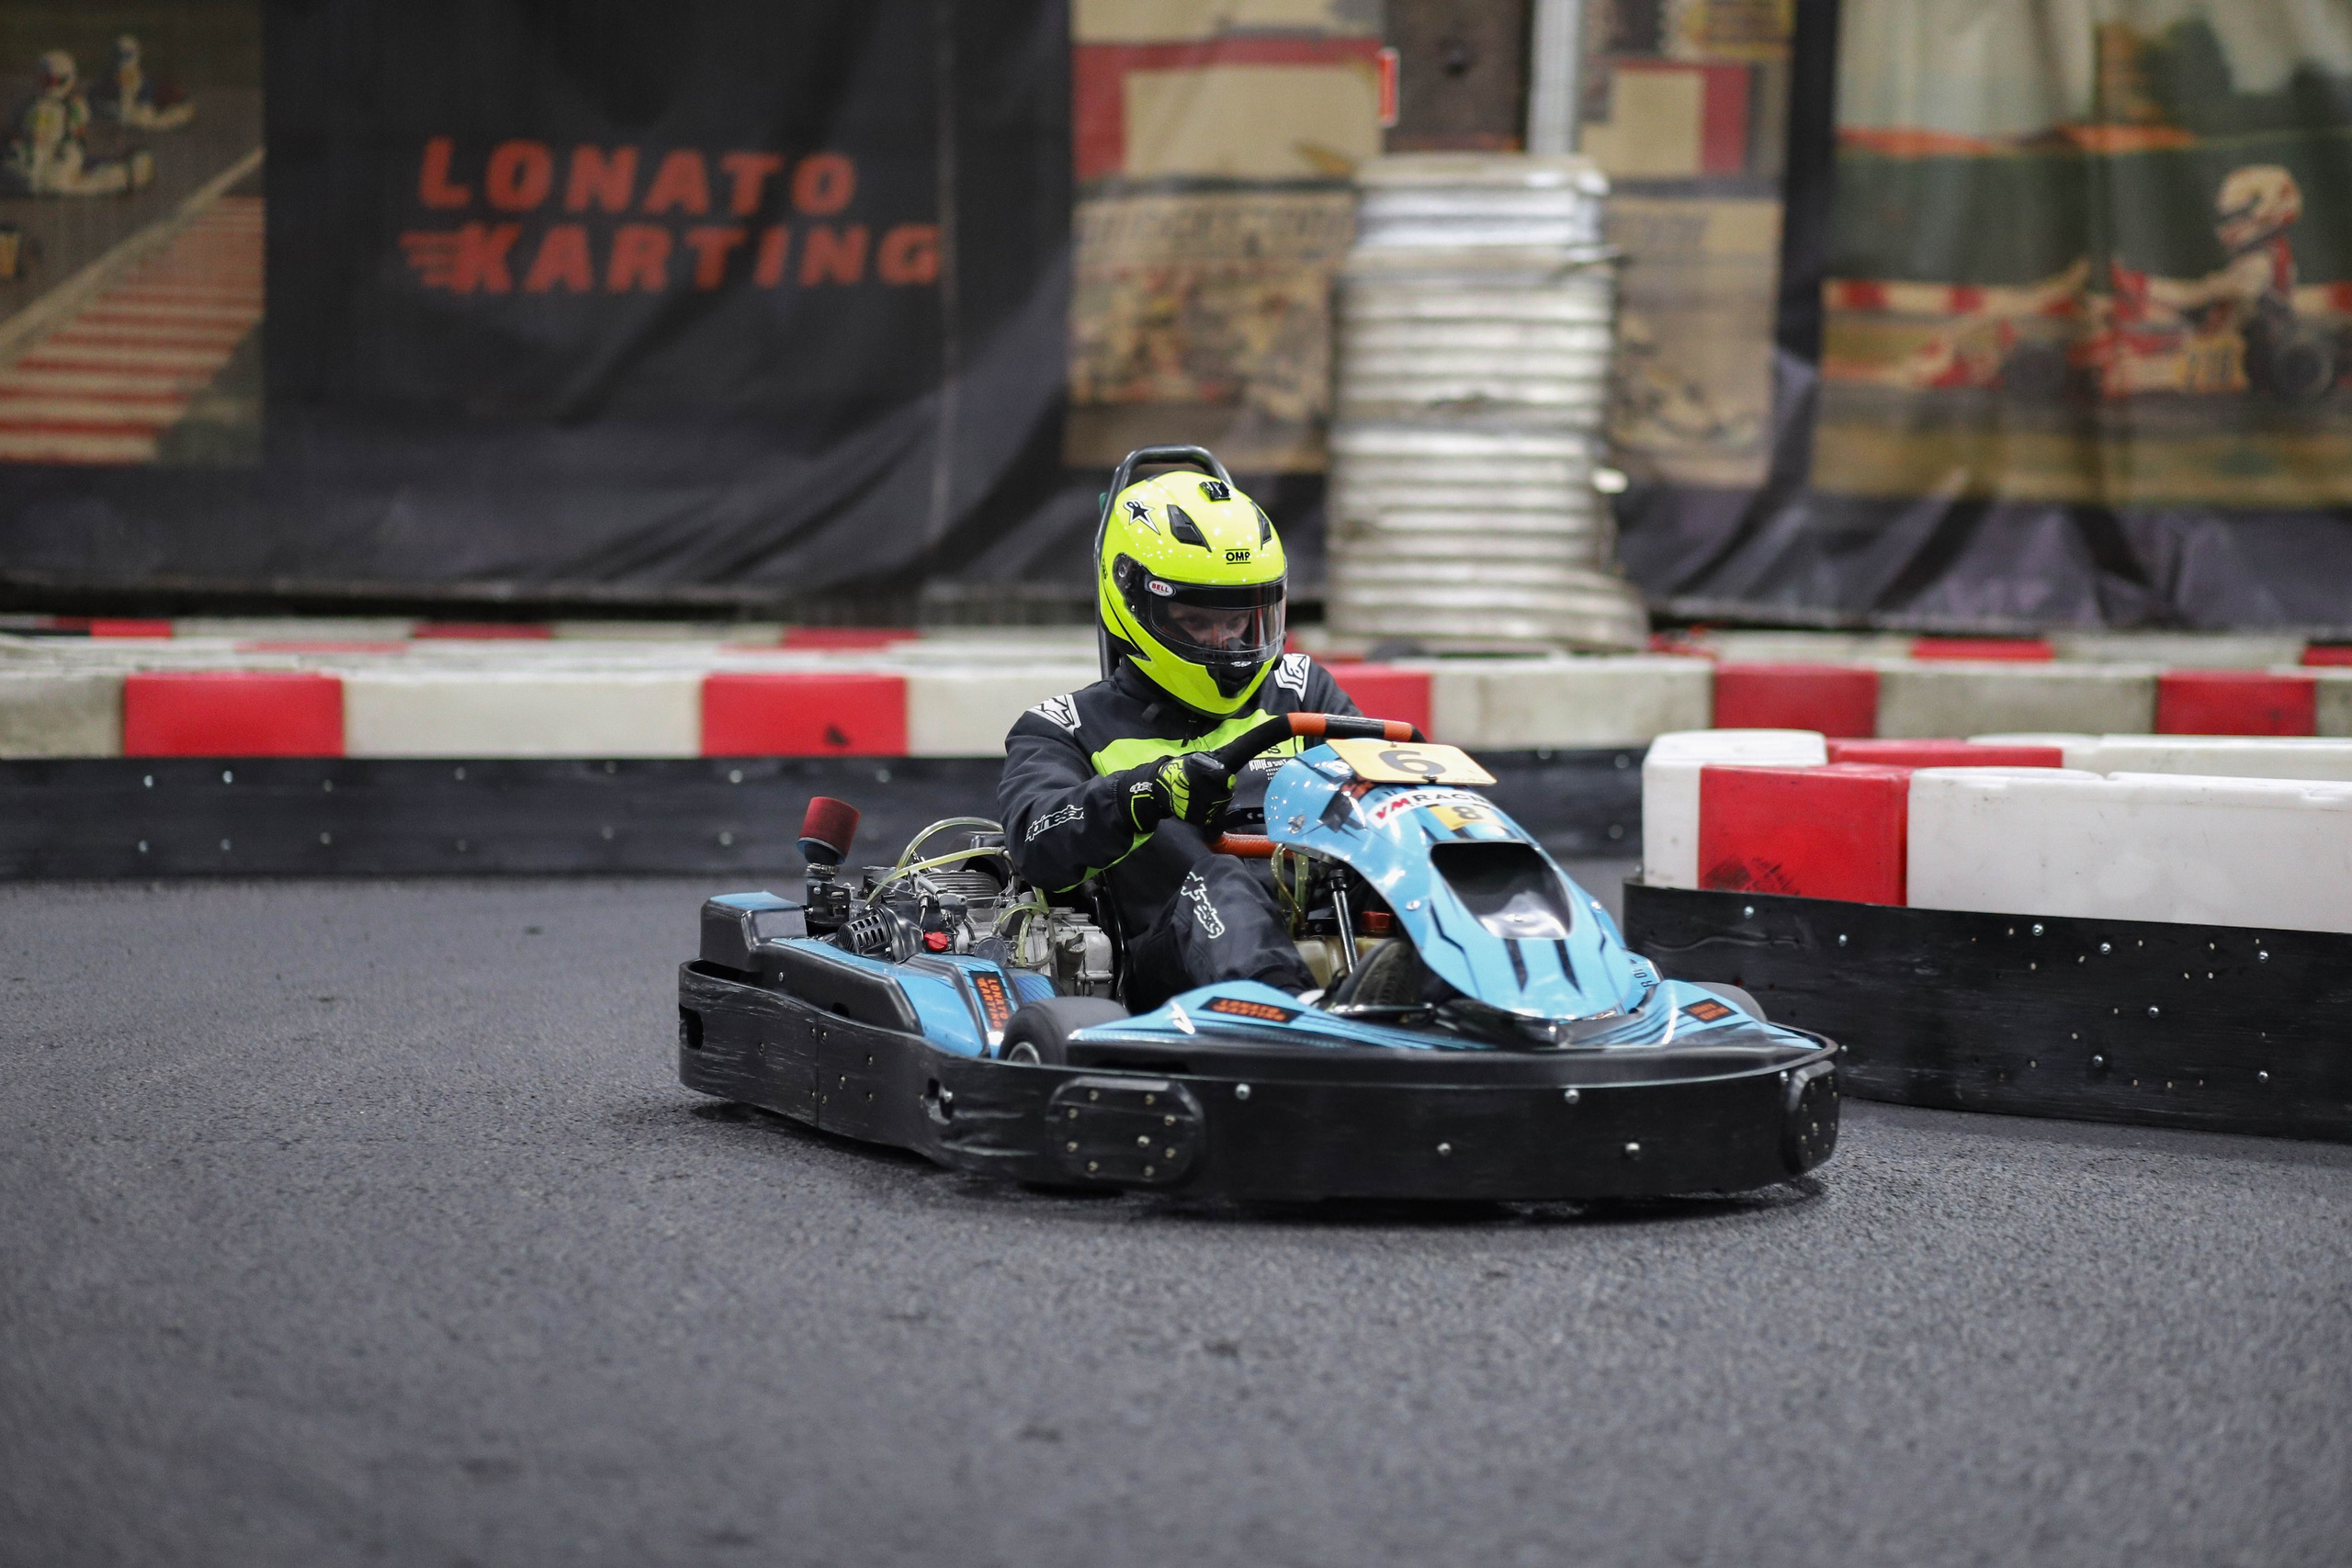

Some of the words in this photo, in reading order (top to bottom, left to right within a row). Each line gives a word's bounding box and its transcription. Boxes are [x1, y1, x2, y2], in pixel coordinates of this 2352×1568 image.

[419, 136, 857, 215] LONATO
[446, 223, 943, 293] KARTING
[1226, 551, 1250, 561] OMP
[1151, 582, 1170, 593] BELL
[1378, 750, 1446, 775] 6
[1452, 806, 1484, 819] 8
[987, 978, 1010, 1021] LONATO
